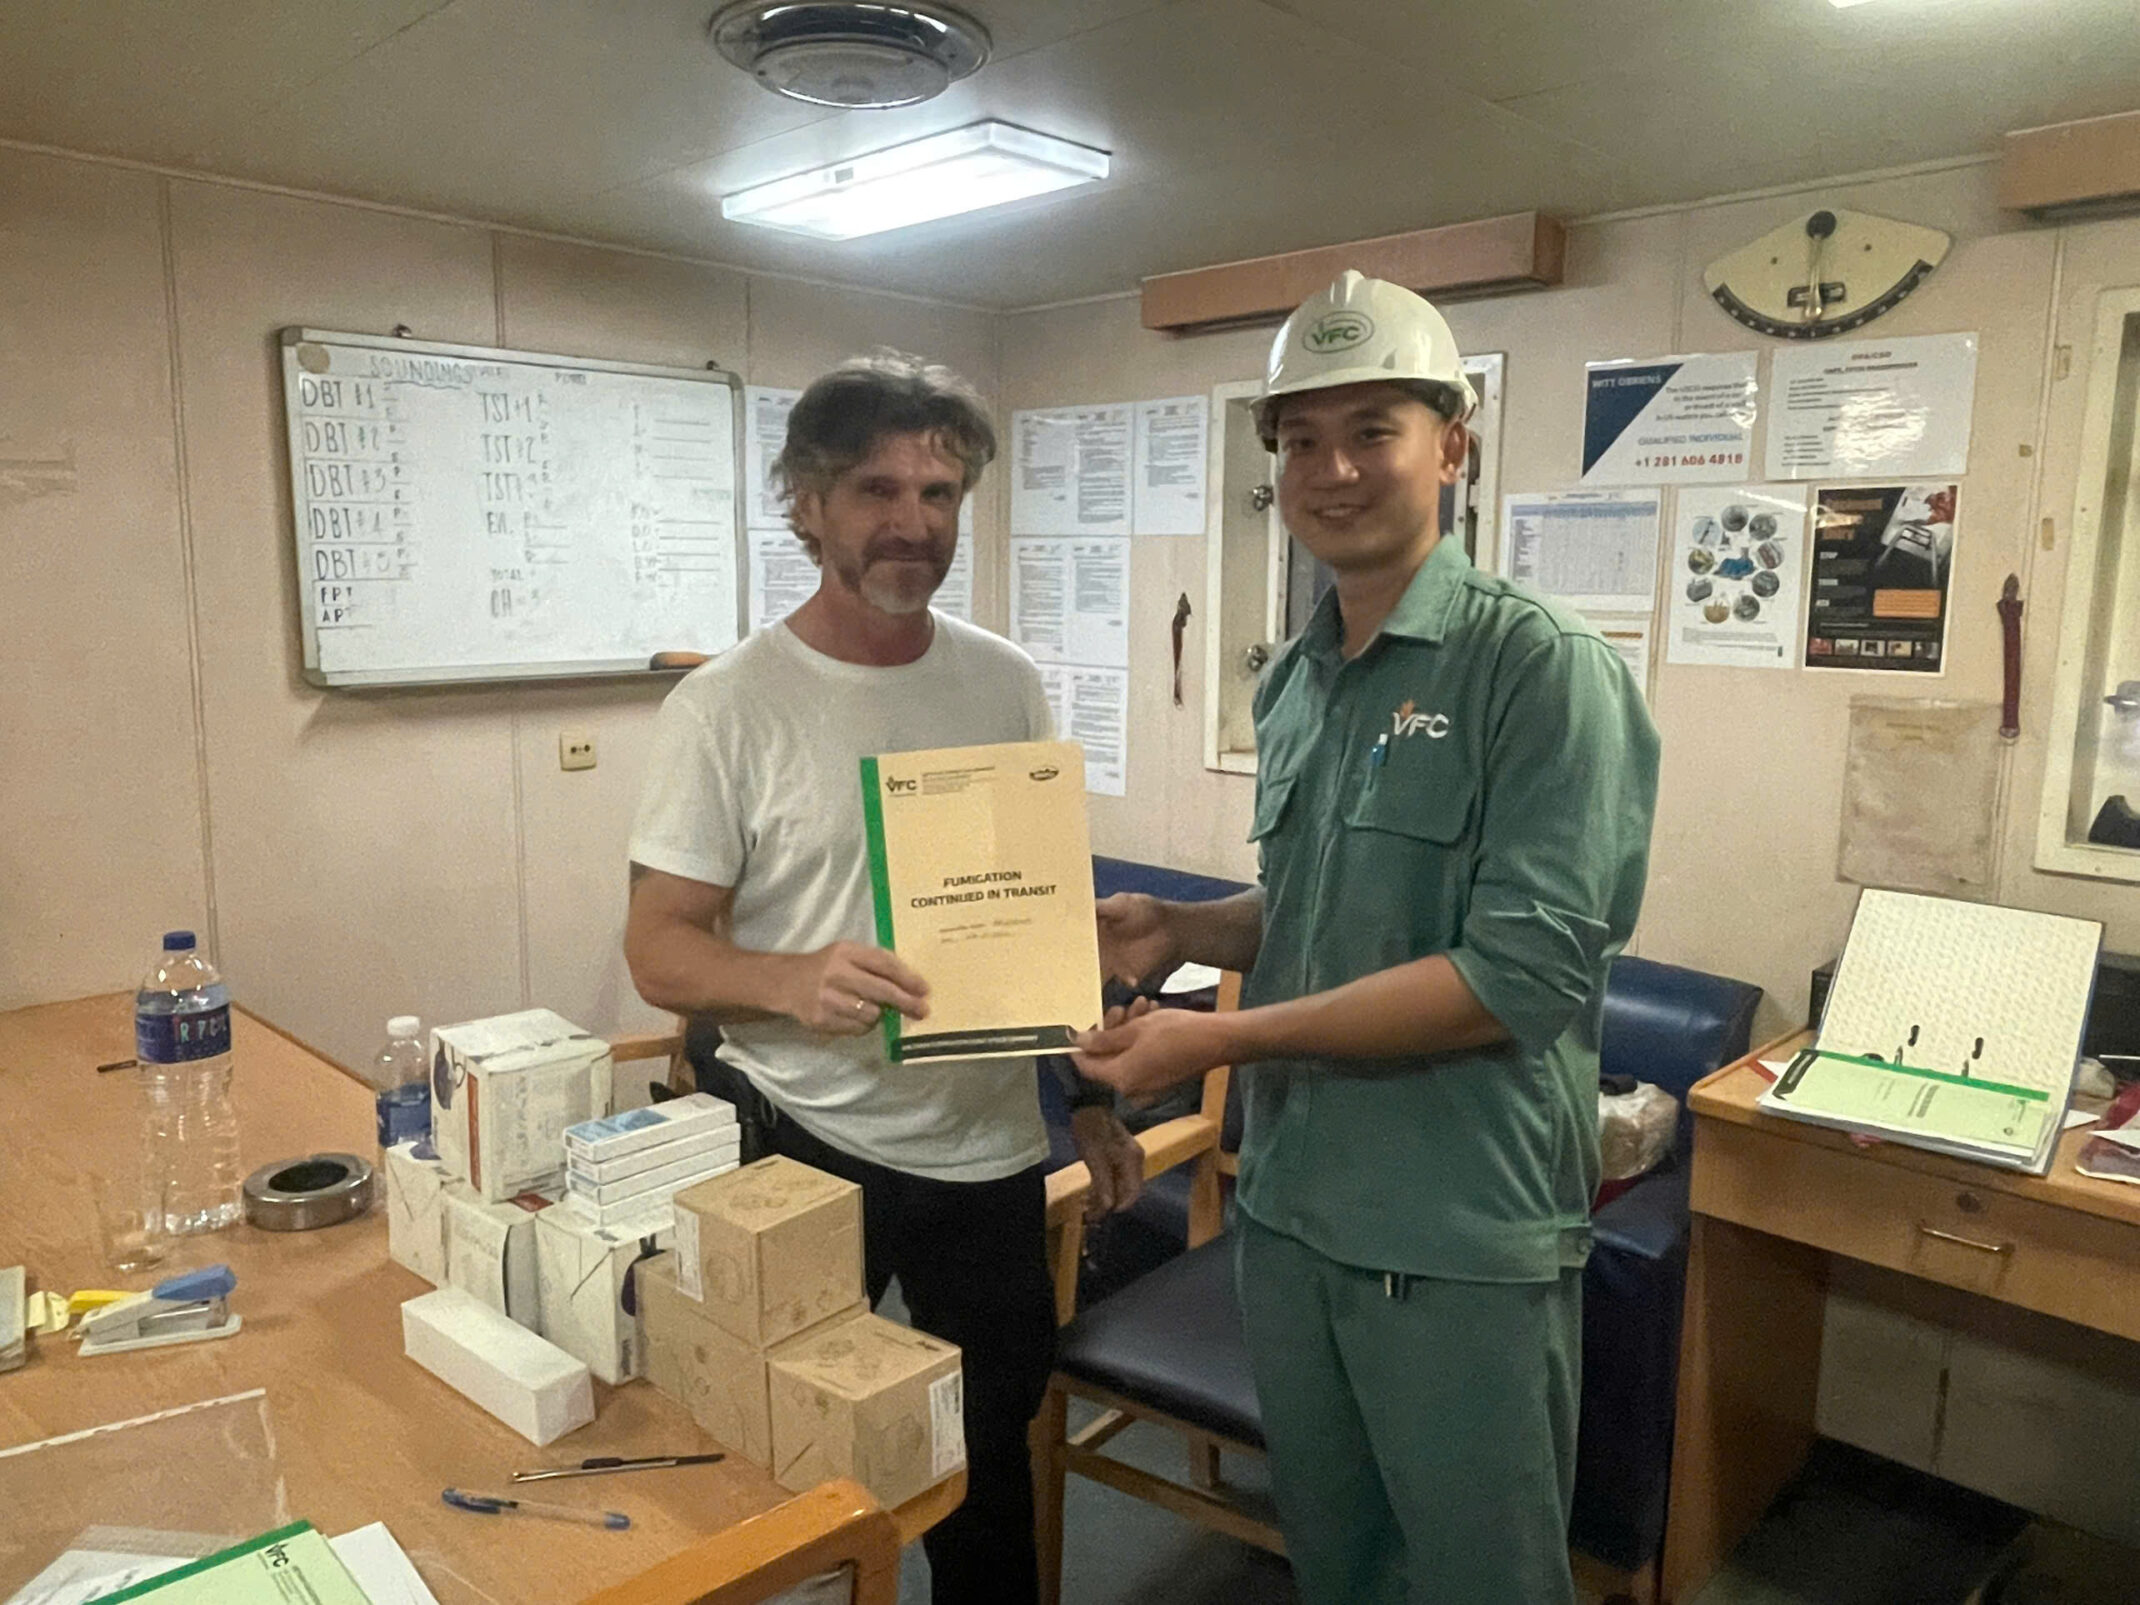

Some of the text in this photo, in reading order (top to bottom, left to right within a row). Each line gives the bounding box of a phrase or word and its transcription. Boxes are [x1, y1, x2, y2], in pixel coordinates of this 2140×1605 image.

[1311, 326, 1360, 346] VFC
[302, 378, 342, 408] DBT
[305, 421, 348, 454] DBT
[1635, 453, 1743, 467] +1 281 606 4818
[309, 464, 353, 497] DBT
[312, 507, 351, 539] DBT
[315, 549, 355, 580] DBT
[1392, 712, 1449, 738] VFC
[886, 777, 917, 793] VFC
[943, 871, 1022, 888] FUMIGATION
[911, 885, 1056, 908] CONTINUED IN TRANSIT
